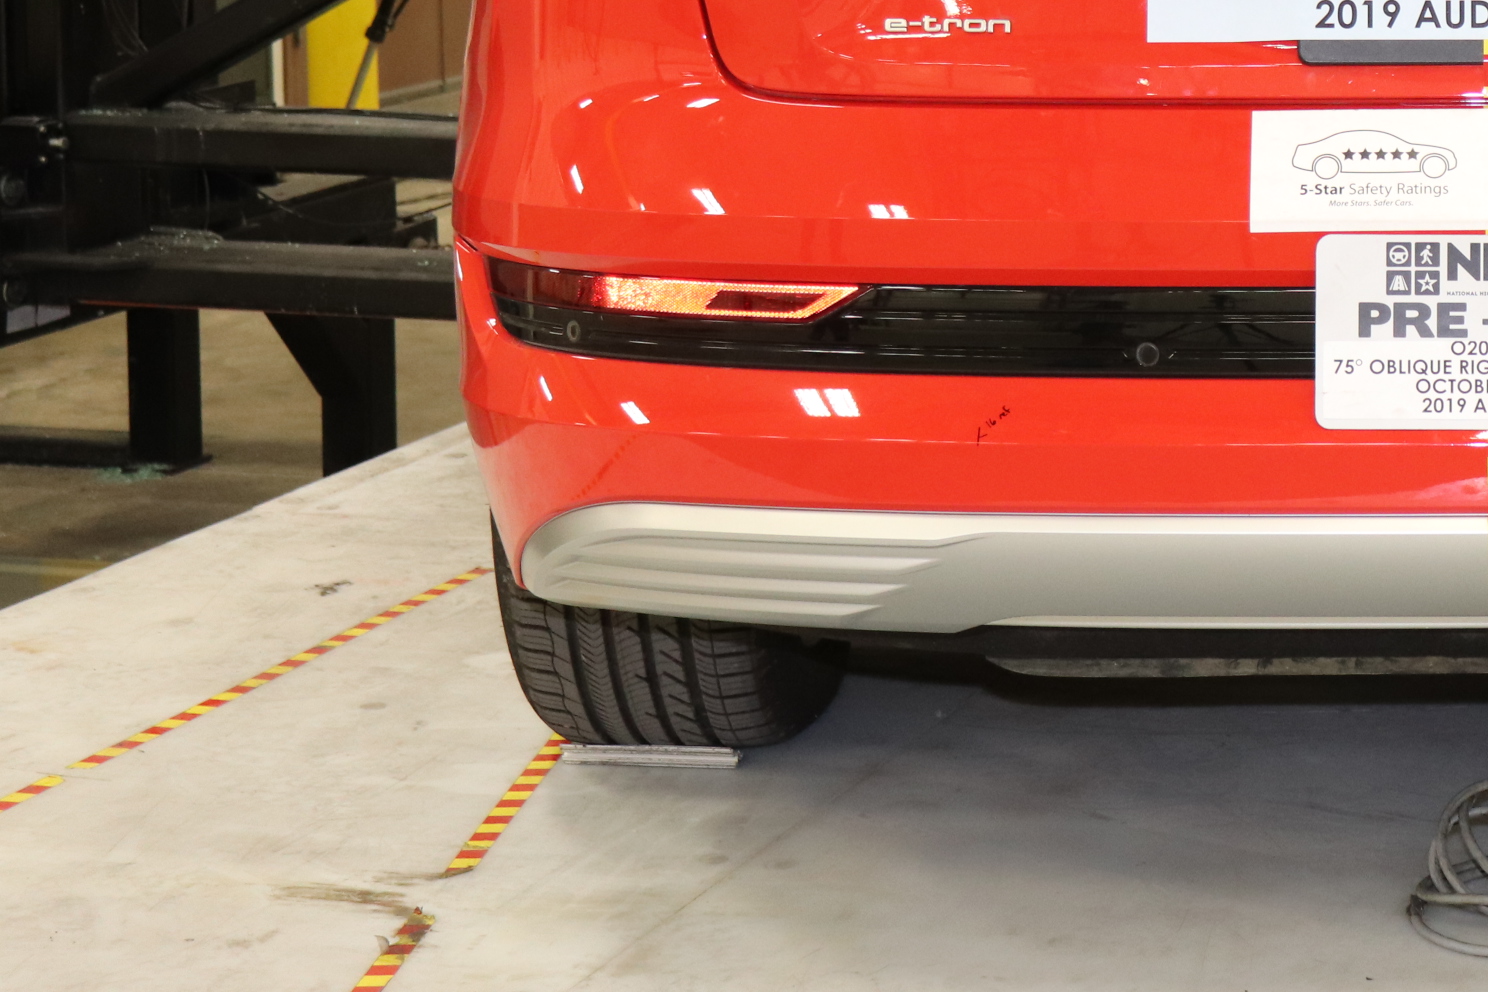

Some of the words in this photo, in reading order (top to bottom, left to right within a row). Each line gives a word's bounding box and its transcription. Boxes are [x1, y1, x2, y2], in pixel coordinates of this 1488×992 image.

[1315, 0, 1401, 29] 2019
[884, 15, 1013, 34] e-tron
[1300, 183, 1345, 195] 5-Star
[1349, 182, 1393, 197] Safety
[1397, 182, 1449, 198] Ratings
[1328, 199, 1349, 207] More
[1350, 199, 1372, 207] Stars.
[1373, 199, 1394, 207] Safer
[1395, 199, 1414, 207] Cars.
[1358, 302, 1468, 338] PRE
[1333, 359, 1363, 374] 75°
[1369, 359, 1452, 376] OBLIQUE
[1422, 397, 1467, 413] 2019
